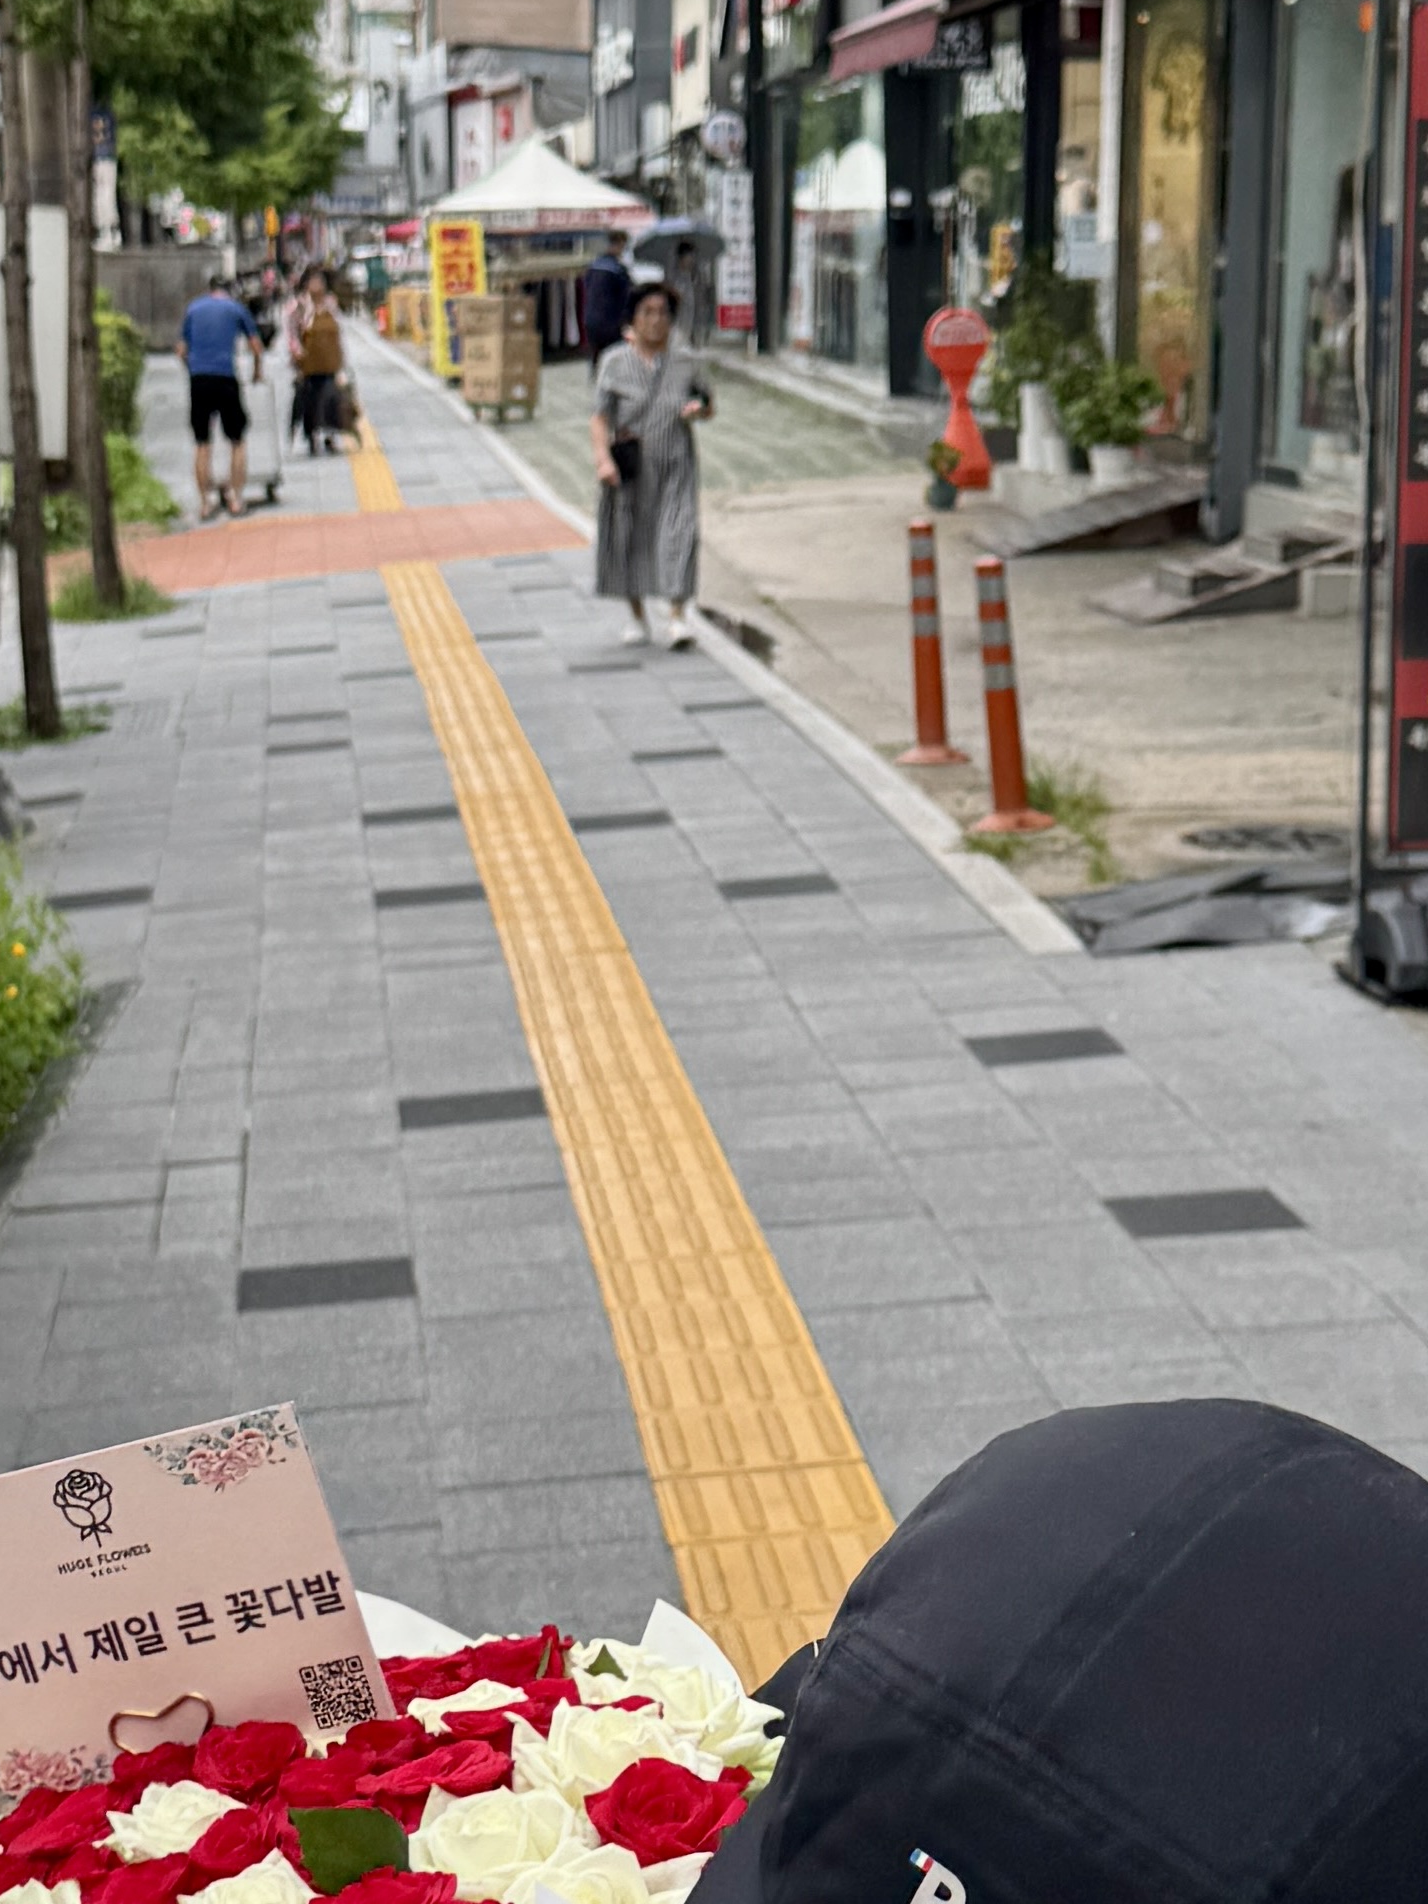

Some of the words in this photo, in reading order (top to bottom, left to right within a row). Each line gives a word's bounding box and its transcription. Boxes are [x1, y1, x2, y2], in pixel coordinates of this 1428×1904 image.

[57, 1556, 94, 1575] HUGE
[97, 1543, 151, 1566] FLOWERS
[91, 1564, 128, 1578] SEOUL
[84, 1610, 168, 1663] 제일
[176, 1602, 216, 1646] 큰
[224, 1569, 346, 1634] 꽃다발
